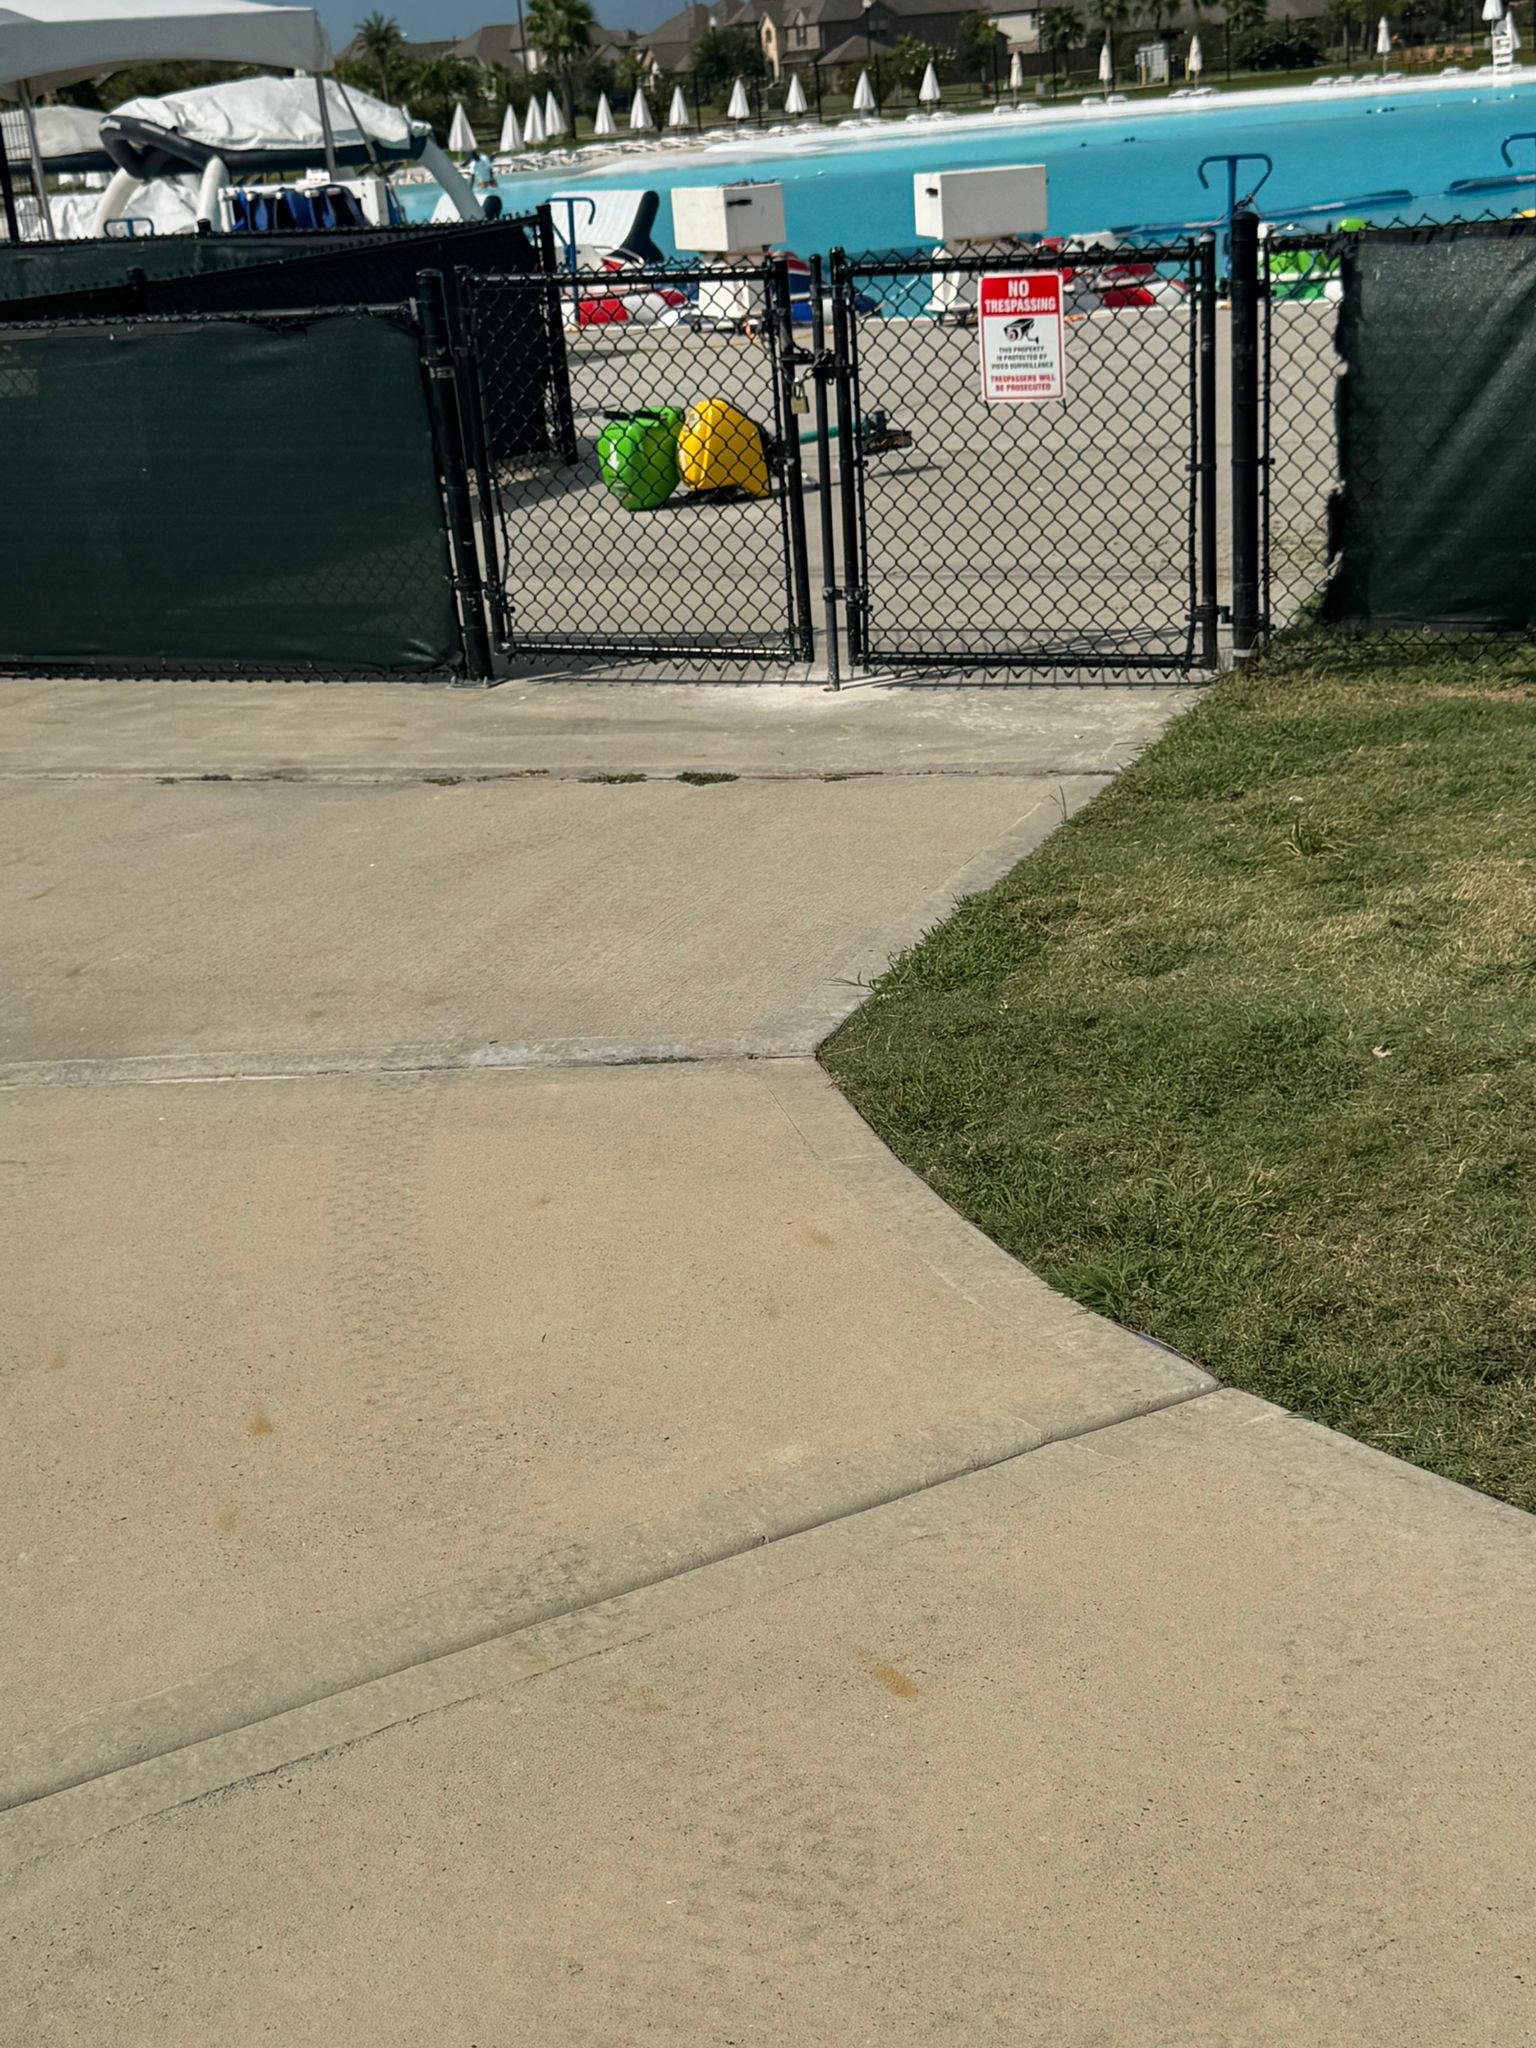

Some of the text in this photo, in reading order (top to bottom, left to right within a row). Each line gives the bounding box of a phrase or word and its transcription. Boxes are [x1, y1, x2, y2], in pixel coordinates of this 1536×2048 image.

[1007, 279, 1030, 297] NO
[985, 297, 1057, 313] TRESPASSING
[991, 374, 1038, 383] TRESPASSERS
[1006, 383, 1051, 391] PROSECUTED
